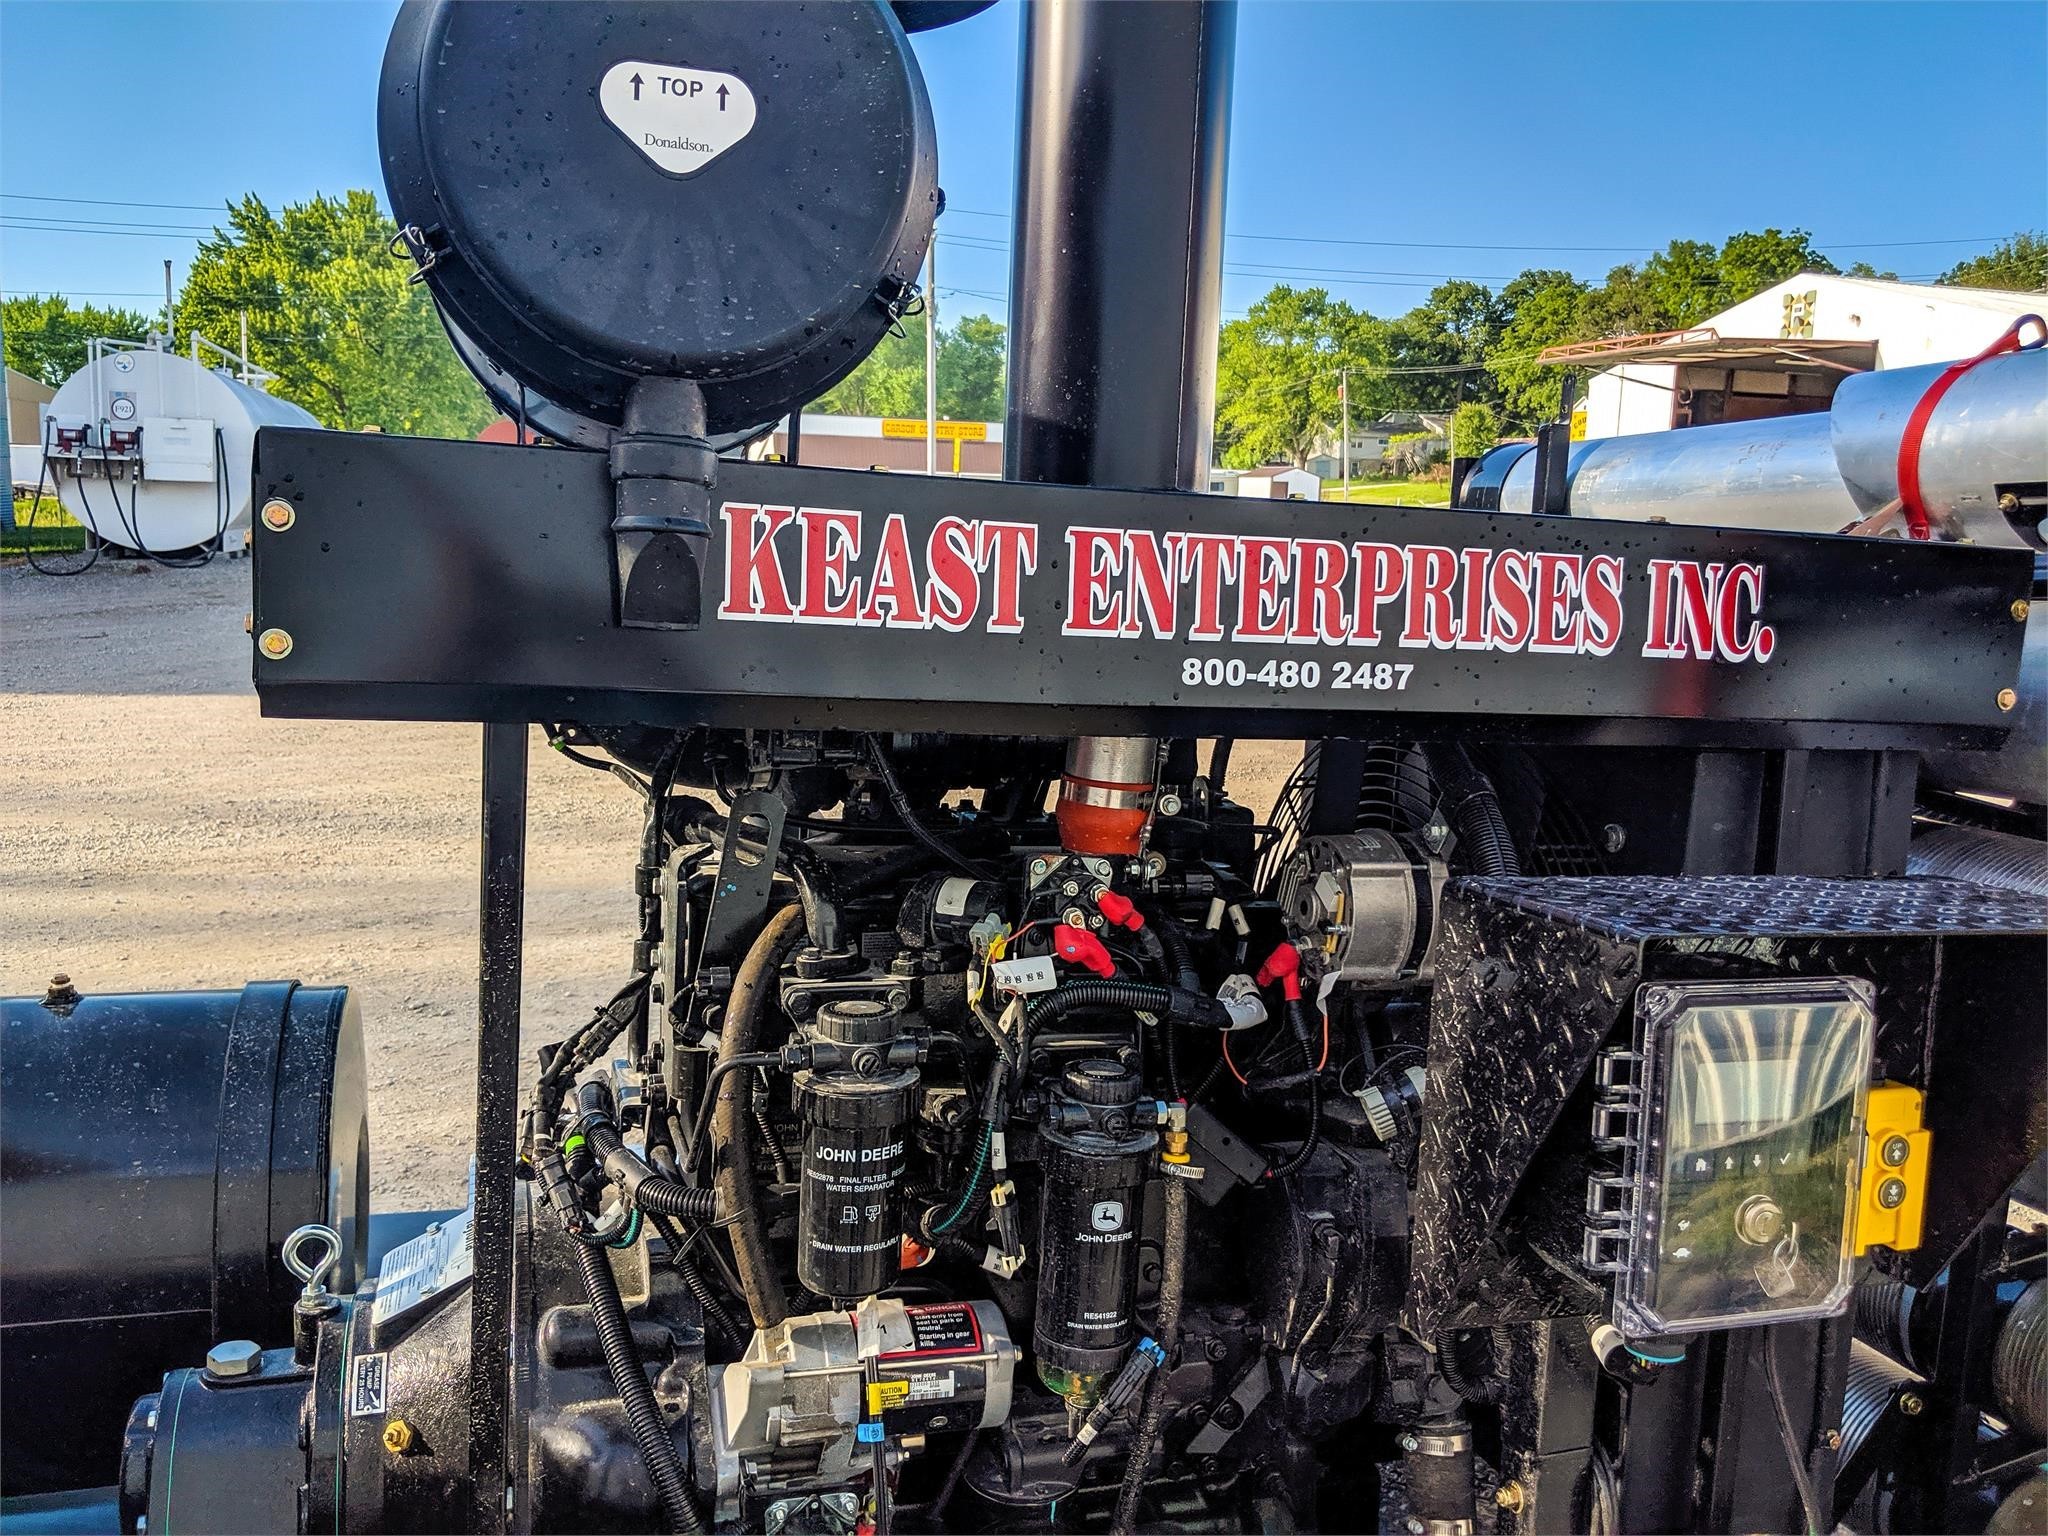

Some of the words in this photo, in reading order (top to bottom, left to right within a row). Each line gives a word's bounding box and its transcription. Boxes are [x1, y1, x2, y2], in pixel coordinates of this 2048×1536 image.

[657, 76, 704, 98] TOP
[919, 423, 955, 436] CONTRY
[958, 425, 984, 437] STORE
[717, 501, 1038, 633] KEAST
[1061, 525, 1624, 657] ENTERPRISES
[1641, 558, 1775, 664] INC.
[1181, 657, 1321, 689] 800-480
[1330, 661, 1414, 690] 2487
[815, 1145, 856, 1163] JOHN
[861, 1140, 904, 1163] DEERE
[1892, 1142, 1902, 1150] UP
[839, 1176, 861, 1184] FINAL
[863, 1173, 887, 1183] FILTER
[825, 1182, 852, 1193] WATER
[853, 1179, 895, 1193] SEPARATOR
[812, 1240, 833, 1251] DRAIN
[834, 1245, 862, 1253] WATER
[863, 1234, 900, 1252] REGULARLY
[1074, 1232, 1103, 1243] JOHN
[1104, 1231, 1133, 1243] DEERE
[939, 1317, 956, 1325] park
[1083, 1311, 1117, 1320] RE541922
[1067, 1321, 1084, 1330] DRAIN
[1103, 1318, 1128, 1330] REGULARLY
[919, 1332, 946, 1340] Starting
[955, 1331, 970, 1339] gear
[373, 1365, 381, 1390] GREASE
[880, 1386, 903, 1395] AUTION
[357, 1387, 365, 1410] HOURS
